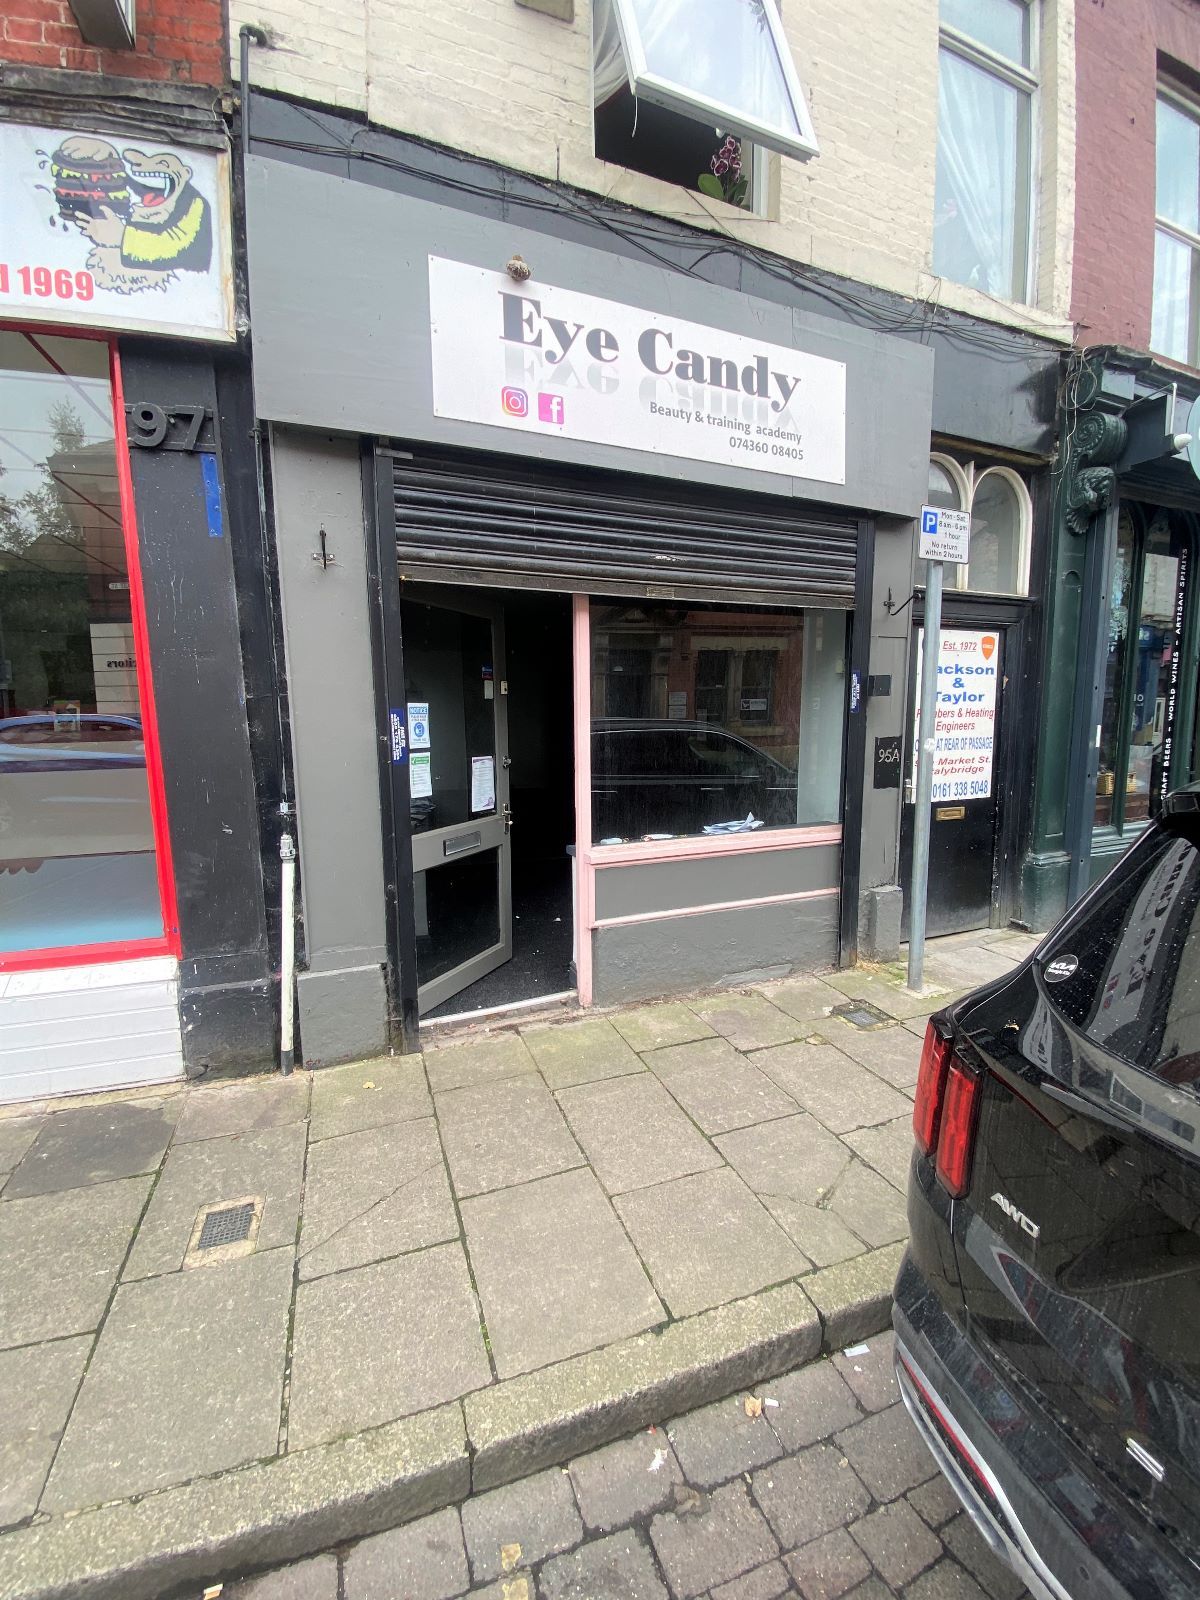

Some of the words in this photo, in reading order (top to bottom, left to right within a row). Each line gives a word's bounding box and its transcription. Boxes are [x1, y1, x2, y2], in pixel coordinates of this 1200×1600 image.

[17, 265, 95, 301] 1969
[498, 290, 620, 364] Eye
[638, 328, 802, 413] Candy
[131, 401, 205, 450] 97
[650, 401, 692, 424] Beauty
[695, 411, 704, 422] &
[707, 413, 751, 435] training
[756, 424, 802, 445] academy
[729, 436, 768, 454] 074360
[771, 444, 804, 460] 08405
[926, 513, 936, 532] P
[941, 511, 953, 520] Mon
[940, 543, 958, 551] return
[948, 551, 963, 560] hours
[1179, 548, 1188, 587] SPIRITS
[1175, 592, 1184, 635] ARTISAN
[943, 640, 958, 650] Est.
[960, 641, 978, 651] 1972
[936, 664, 995, 675] ackson
[1171, 651, 1179, 683] WINES
[952, 677, 965, 689] &
[957, 707, 963, 718] &
[965, 707, 995, 720] Heating
[1168, 688, 1176, 721] WORLD
[936, 721, 976, 733] Engineers
[936, 738, 943, 751] AT
[944, 737, 960, 751] REAR
[960, 737, 968, 750] OF
[968, 736, 993, 750] PASSAGE
[1163, 737, 1172, 767] BEERS
[878, 748, 900, 763] 95A
[938, 756, 975, 766] Market
[978, 755, 991, 764] St.
[932, 765, 985, 776] alybridge
[932, 782, 951, 798] 0161
[954, 781, 967, 796] 338
[970, 779, 988, 795] 5048
[990, 1192, 1041, 1239] AWD
